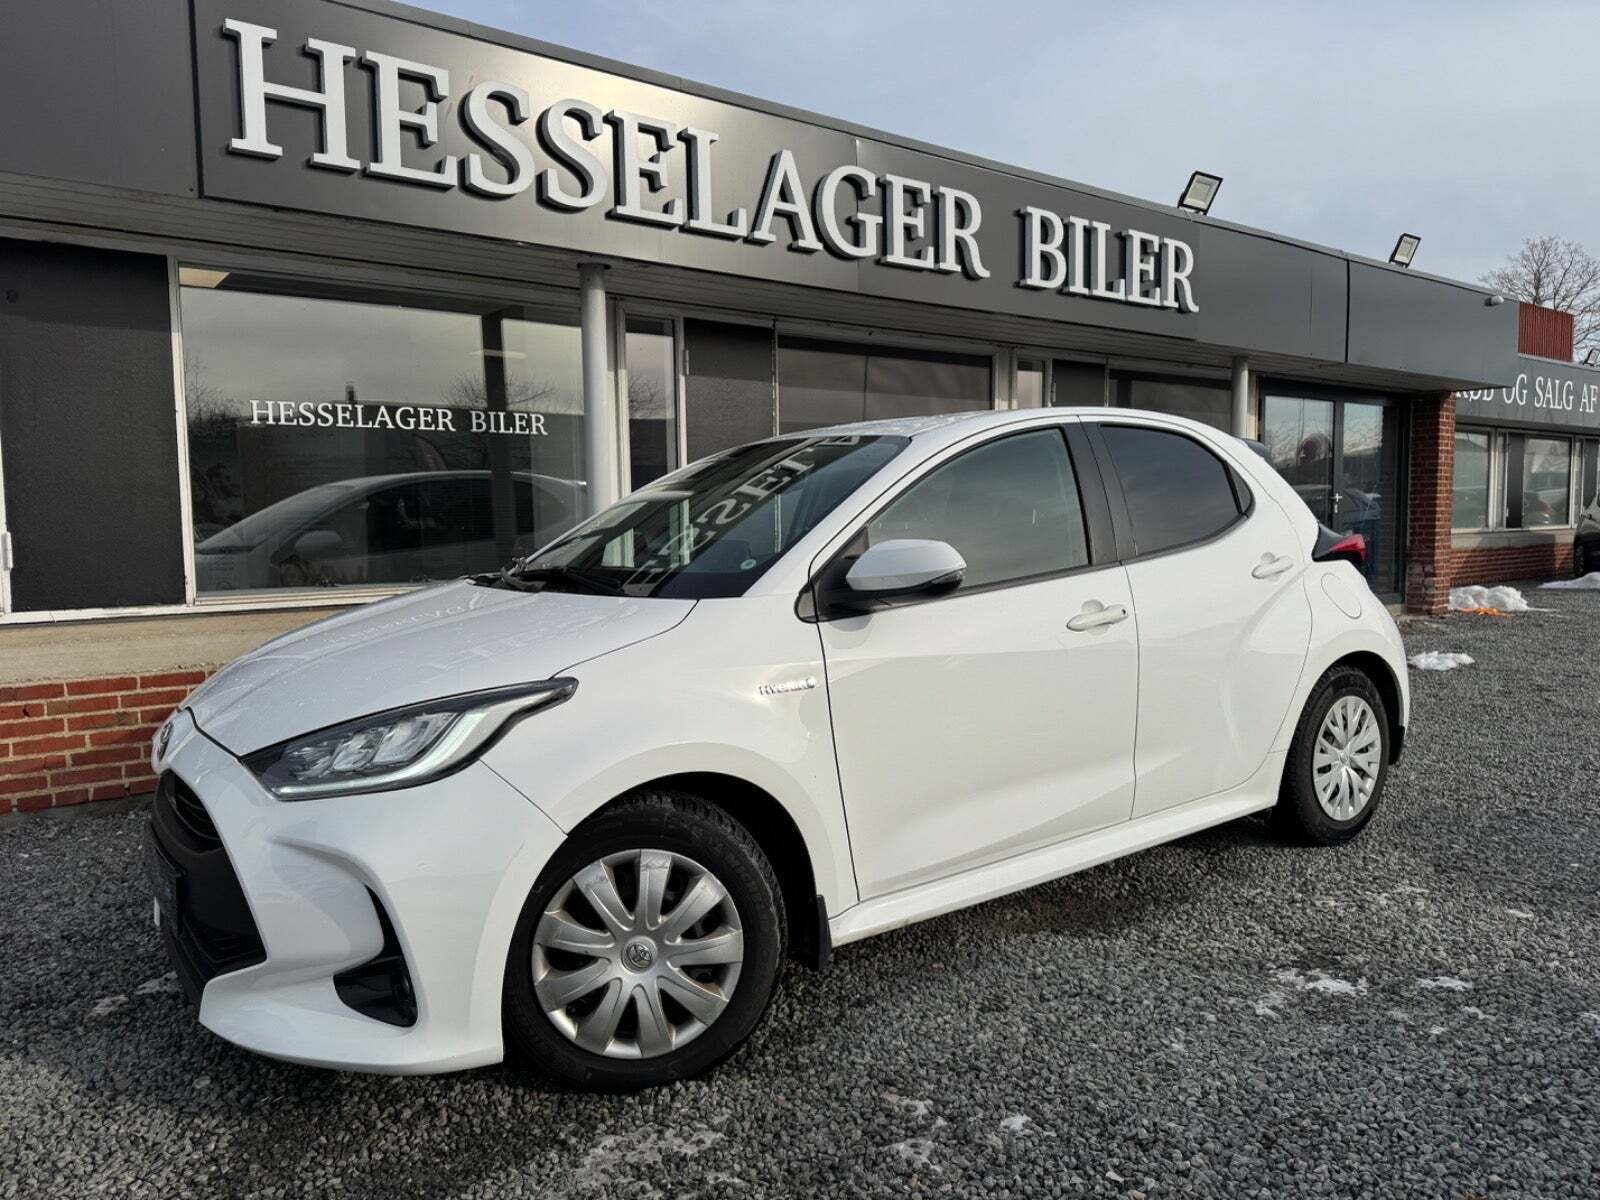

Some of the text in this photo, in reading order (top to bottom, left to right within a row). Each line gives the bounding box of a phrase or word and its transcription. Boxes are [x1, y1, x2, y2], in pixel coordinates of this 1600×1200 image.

[222, 18, 1200, 313] HESSELAGER BILER
[1534, 376, 1574, 411] SALG
[1579, 383, 1600, 413] AF
[249, 399, 548, 436] HESSELAGER BILER
